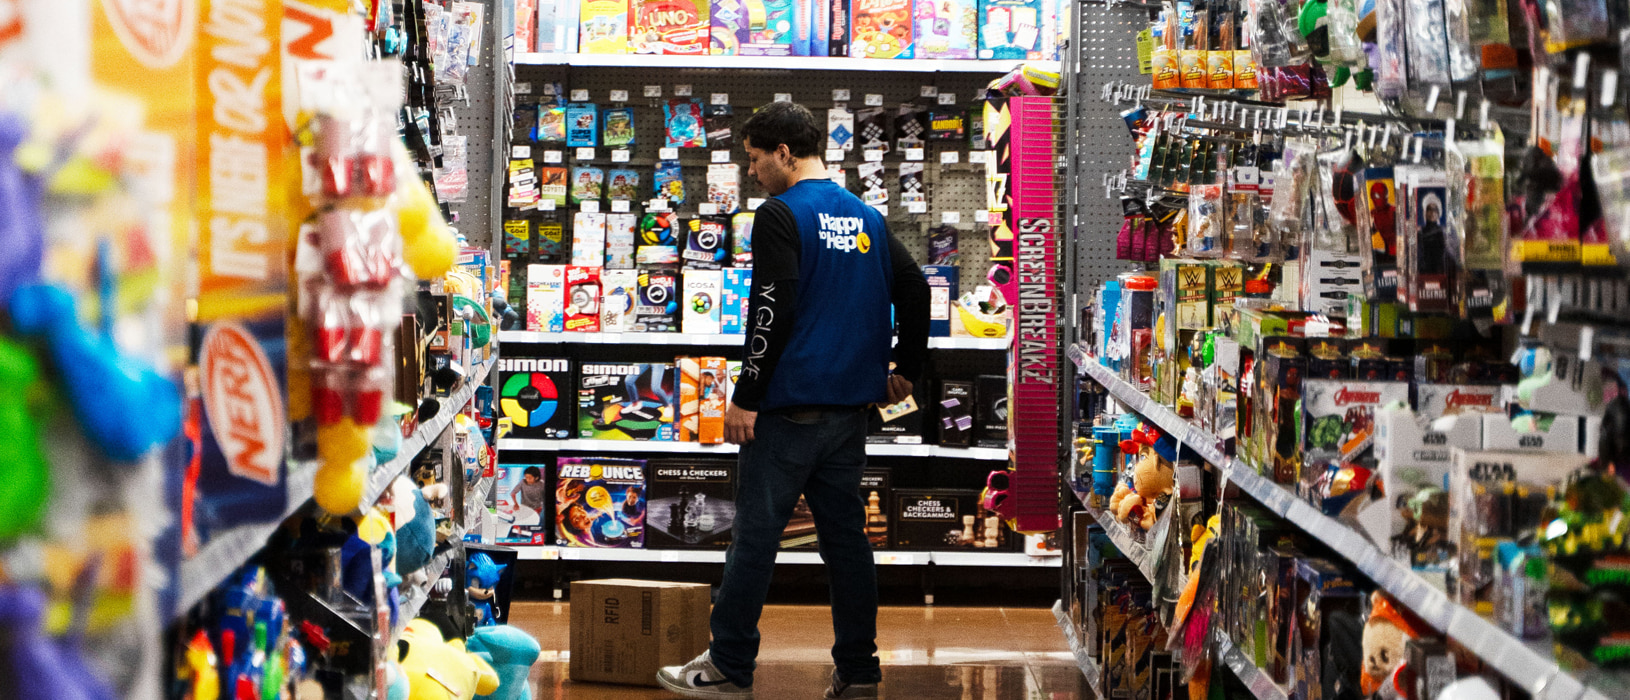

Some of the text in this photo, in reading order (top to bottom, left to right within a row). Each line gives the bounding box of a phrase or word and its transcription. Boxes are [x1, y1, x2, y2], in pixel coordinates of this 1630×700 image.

[649, 10, 688, 27] UNO
[208, 66, 273, 134] OR
[818, 213, 863, 234] Happy
[742, 306, 774, 381] GLOVE
[582, 364, 640, 375] simon
[215, 340, 270, 477] NERF
[604, 597, 620, 625] RFID
